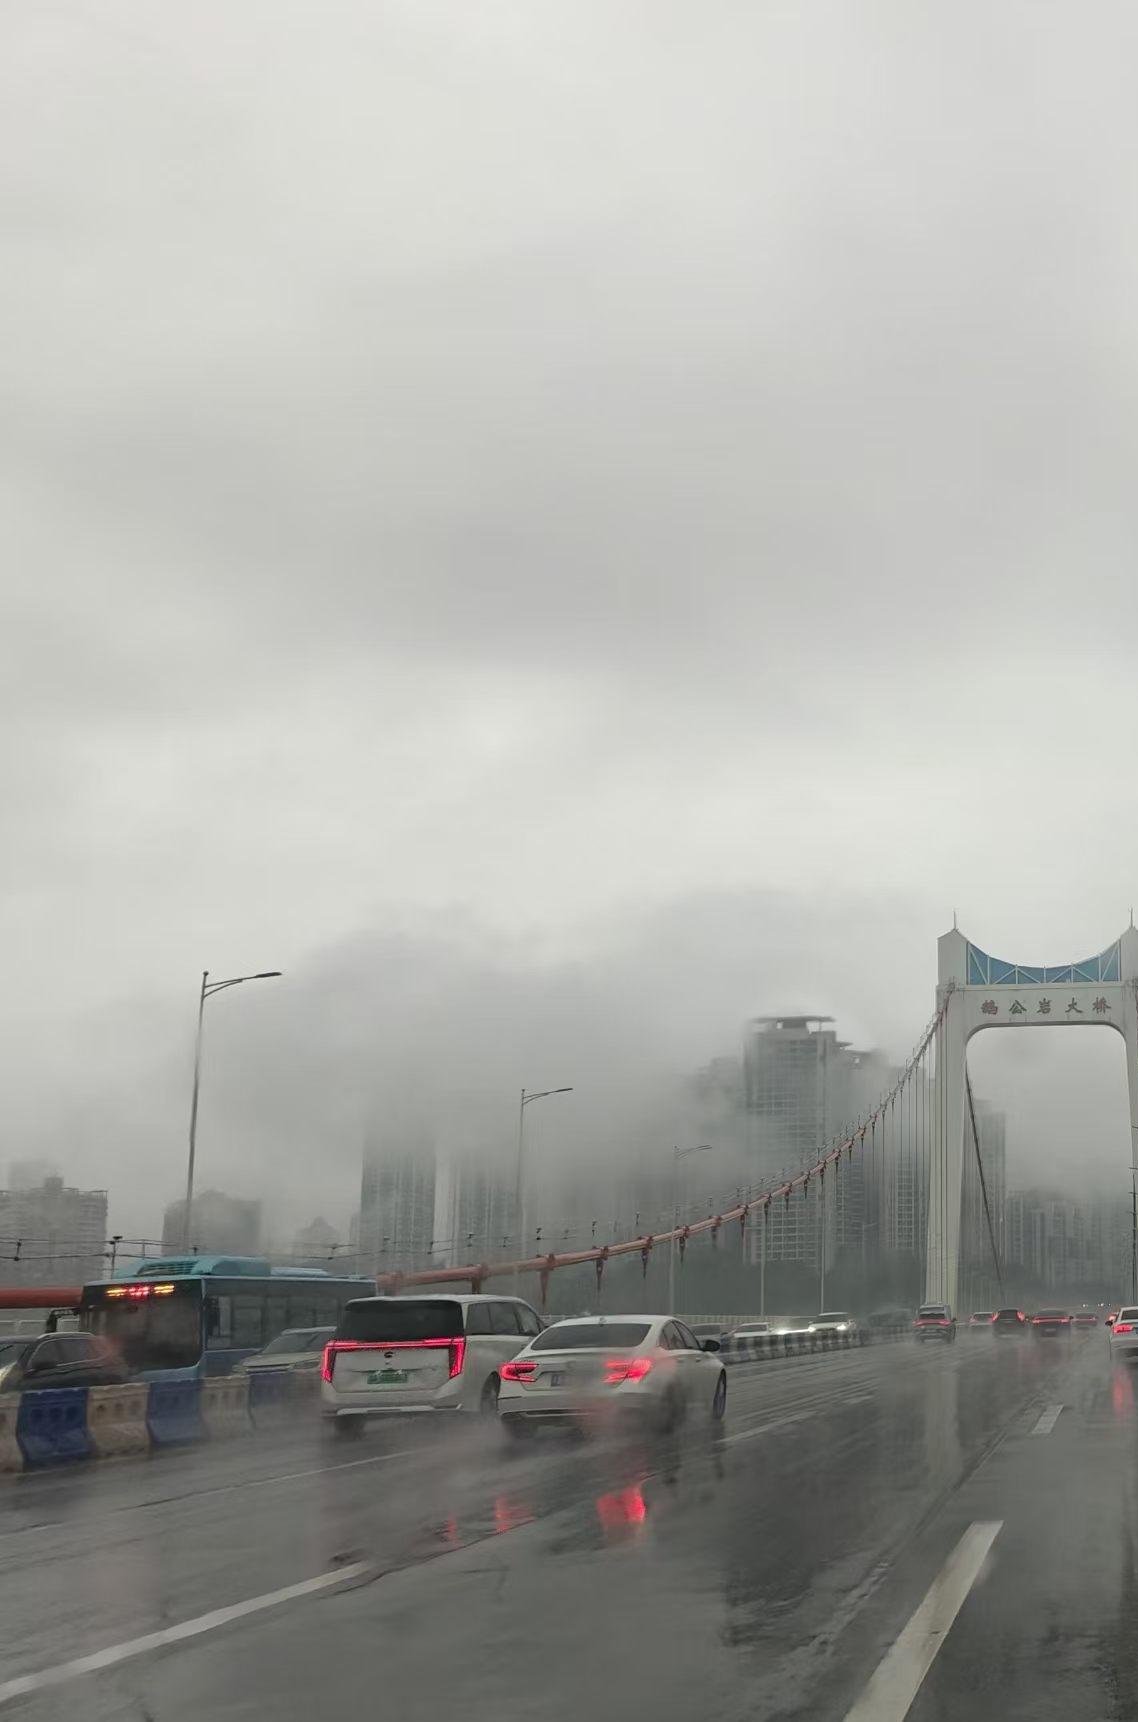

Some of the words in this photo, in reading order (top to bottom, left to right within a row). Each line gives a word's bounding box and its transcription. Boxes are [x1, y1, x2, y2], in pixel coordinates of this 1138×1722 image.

[981, 997, 1111, 1015] 鹅公岩大桥
